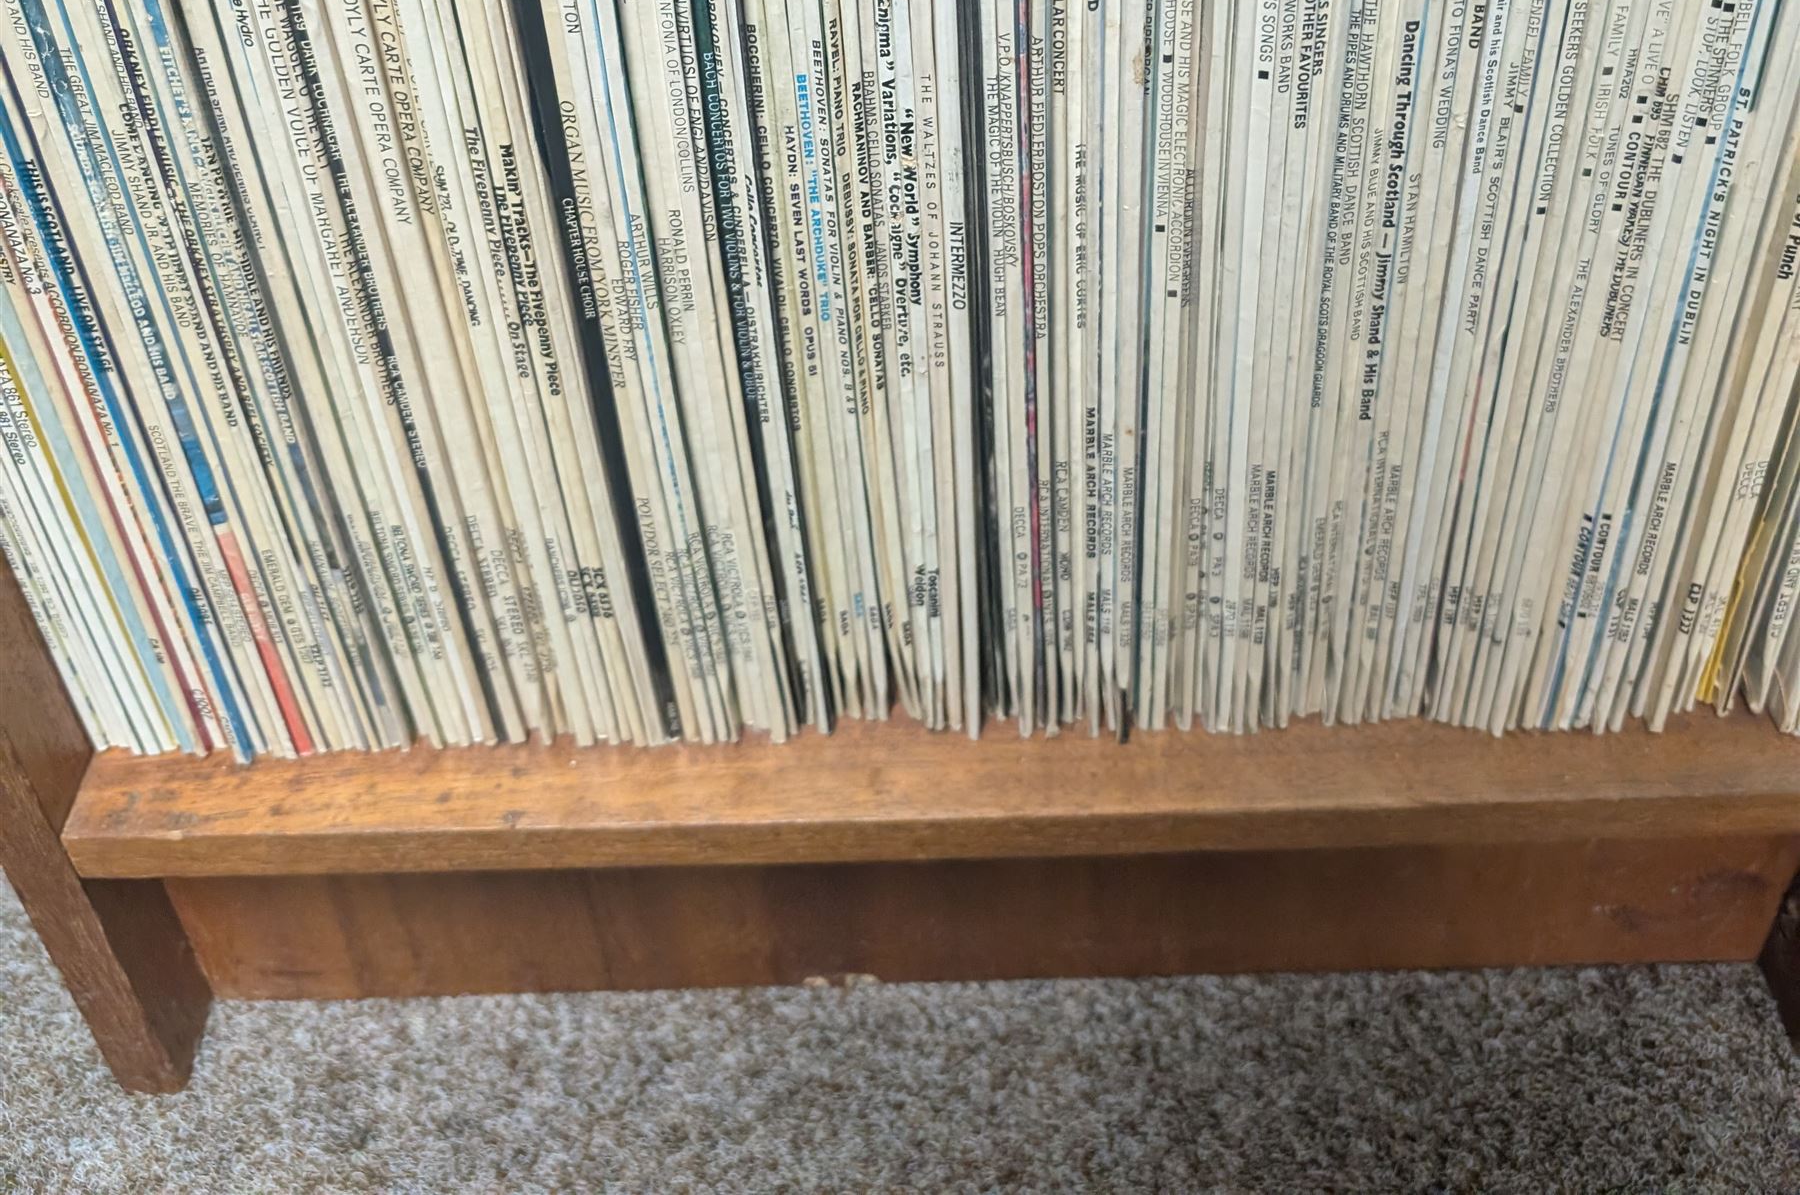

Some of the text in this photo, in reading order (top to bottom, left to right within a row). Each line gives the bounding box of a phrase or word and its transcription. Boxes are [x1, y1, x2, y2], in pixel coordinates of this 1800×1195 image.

[232, 9, 257, 48] Hydro
[1258, 15, 1275, 62] SONGS
[1488, 39, 1501, 56] his
[1491, 14, 1505, 35] and
[1605, 5, 1629, 56] FAMILY
[1642, 42, 1663, 70] LIVE
[1650, 27, 1666, 38] A
[1052, 29, 1065, 95] CONCERT
[1291, 44, 1313, 129] FAVOURITES
[1479, 59, 1499, 105] Scottish
[1639, 74, 1655, 84] O
[1720, 43, 1742, 76] FOLK
[378, 30, 405, 85] CARTE
[392, 91, 418, 140] OPERA
[406, 146, 435, 214] COMPANY
[1475, 109, 1490, 142] Dance
[1592, 83, 1612, 119] IRISH
[1706, 84, 1732, 130] GROUP
[1470, 146, 1485, 174] Band
[1584, 128, 1602, 158] FOLK
[109, 129, 191, 327] JIMMY SHAND JR. AND HIS BAND
[794, 74, 814, 165] BEETHOVEN:
[817, 291, 830, 322] TRIO
[878, 78, 900, 165] Variations,
[898, 353, 911, 377] etc.
[919, 75, 944, 369] THE WALTZES OF JOHANN STRAUSS
[1357, 20, 1421, 420] Dancing Through Scotland Jimmy Shand & His Band
[1607, 93, 1680, 343] SHM 682 THE DUBLINERS IN CONCERT
[1676, 87, 1752, 345] ST. PATRICK'S NIGHT IN DUBLIN
[558, 100, 625, 388] ORGAN MUSIC FROM YORK MINSTER
[560, 197, 596, 319] CHAPTER HOUSE CHOIR
[668, 209, 694, 312] RONALD PERRIN
[783, 125, 817, 376] HAYDN: SEVEN LAST WORDS OPUS 51
[903, 232, 923, 305] Symphony
[948, 221, 967, 310] INTERMEZZO
[656, 237, 685, 344] HARRISON OXLEY
[1085, 407, 1096, 559] MARBLE ARCH RECORDS
[926, 568, 940, 618] Toscanini
